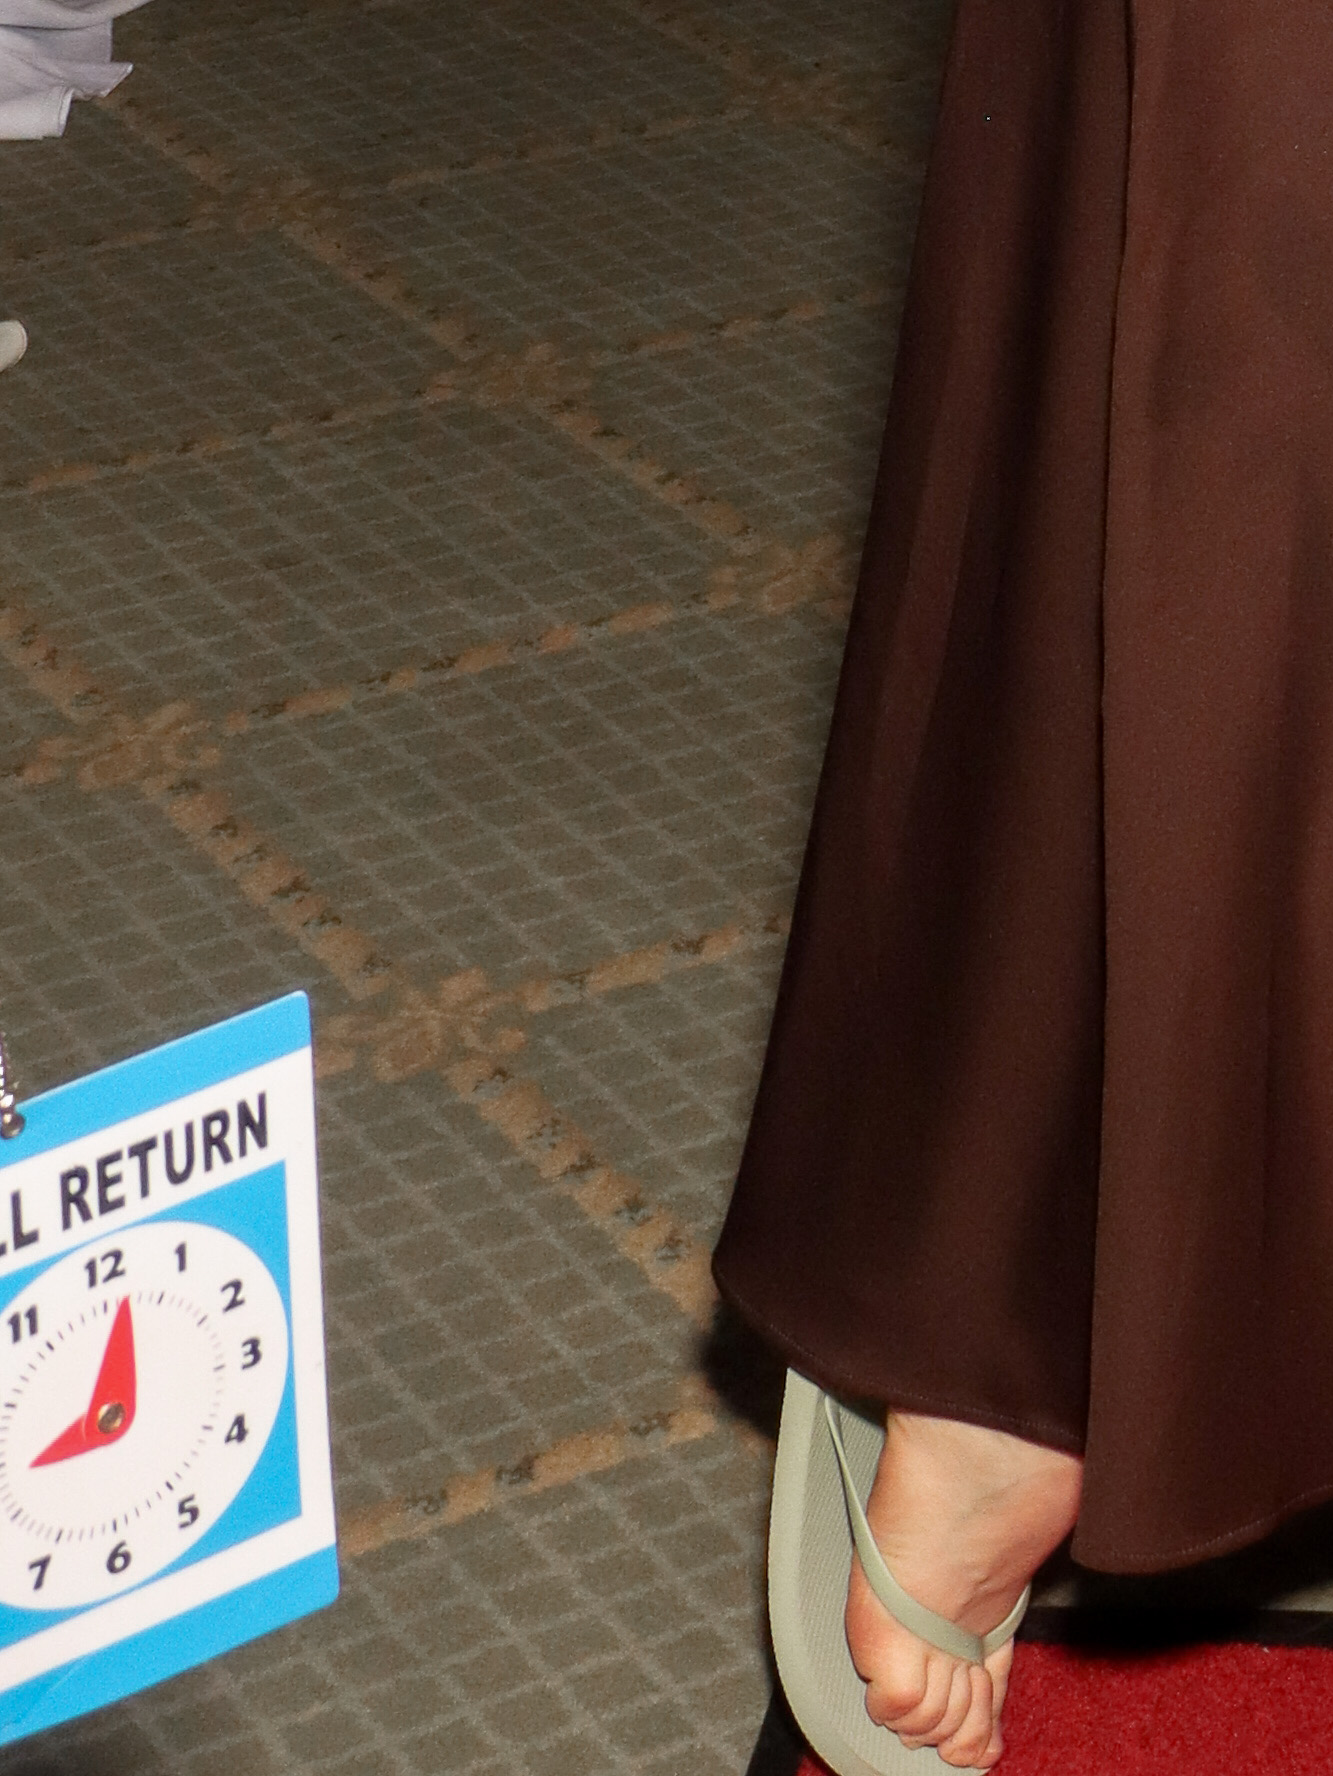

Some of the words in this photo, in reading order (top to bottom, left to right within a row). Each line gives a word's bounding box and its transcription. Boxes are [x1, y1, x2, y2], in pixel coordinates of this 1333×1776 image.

[0, 1188, 39, 1256] L
[59, 1091, 268, 1231] RETURN
[84, 1249, 125, 1288] 12
[174, 1241, 187, 1272] 1
[220, 1279, 245, 1312] 2
[7, 1305, 39, 1344] 11
[241, 1337, 262, 1370] 3
[224, 1413, 249, 1444] 4
[178, 1494, 200, 1529] 5
[28, 1554, 52, 1591] 7
[105, 1541, 132, 1574] 6
